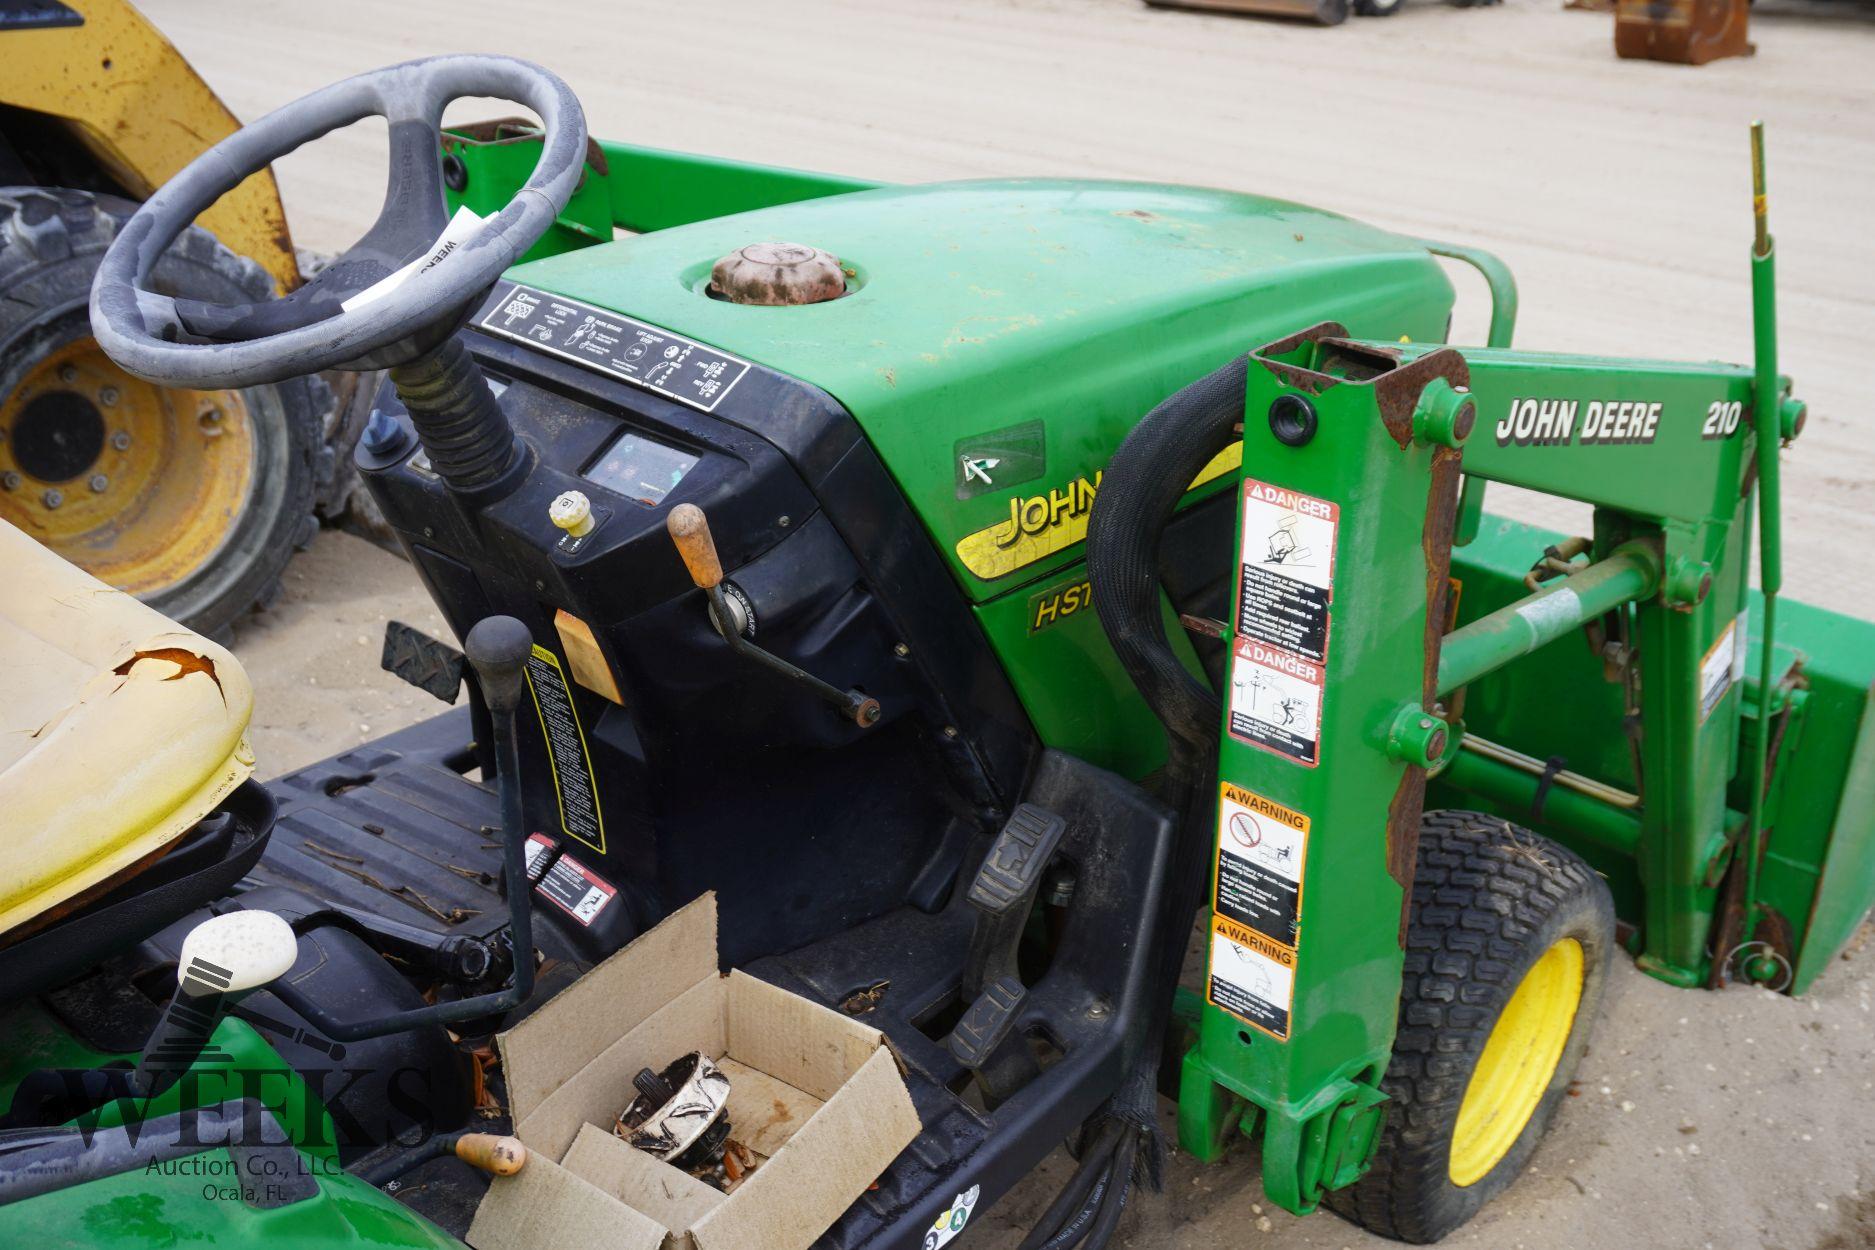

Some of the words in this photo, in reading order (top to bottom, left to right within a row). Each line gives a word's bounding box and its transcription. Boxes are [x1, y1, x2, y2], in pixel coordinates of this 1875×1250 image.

[1496, 398, 1578, 445] JOHN
[1580, 400, 1662, 443] DEERE
[1702, 400, 1742, 436] 210
[996, 470, 1104, 549] JOHN
[1264, 487, 1331, 519] DANGER
[1253, 648, 1317, 682] DANGER
[1237, 792, 1304, 829] WARNING
[1228, 925, 1292, 965] WARNING
